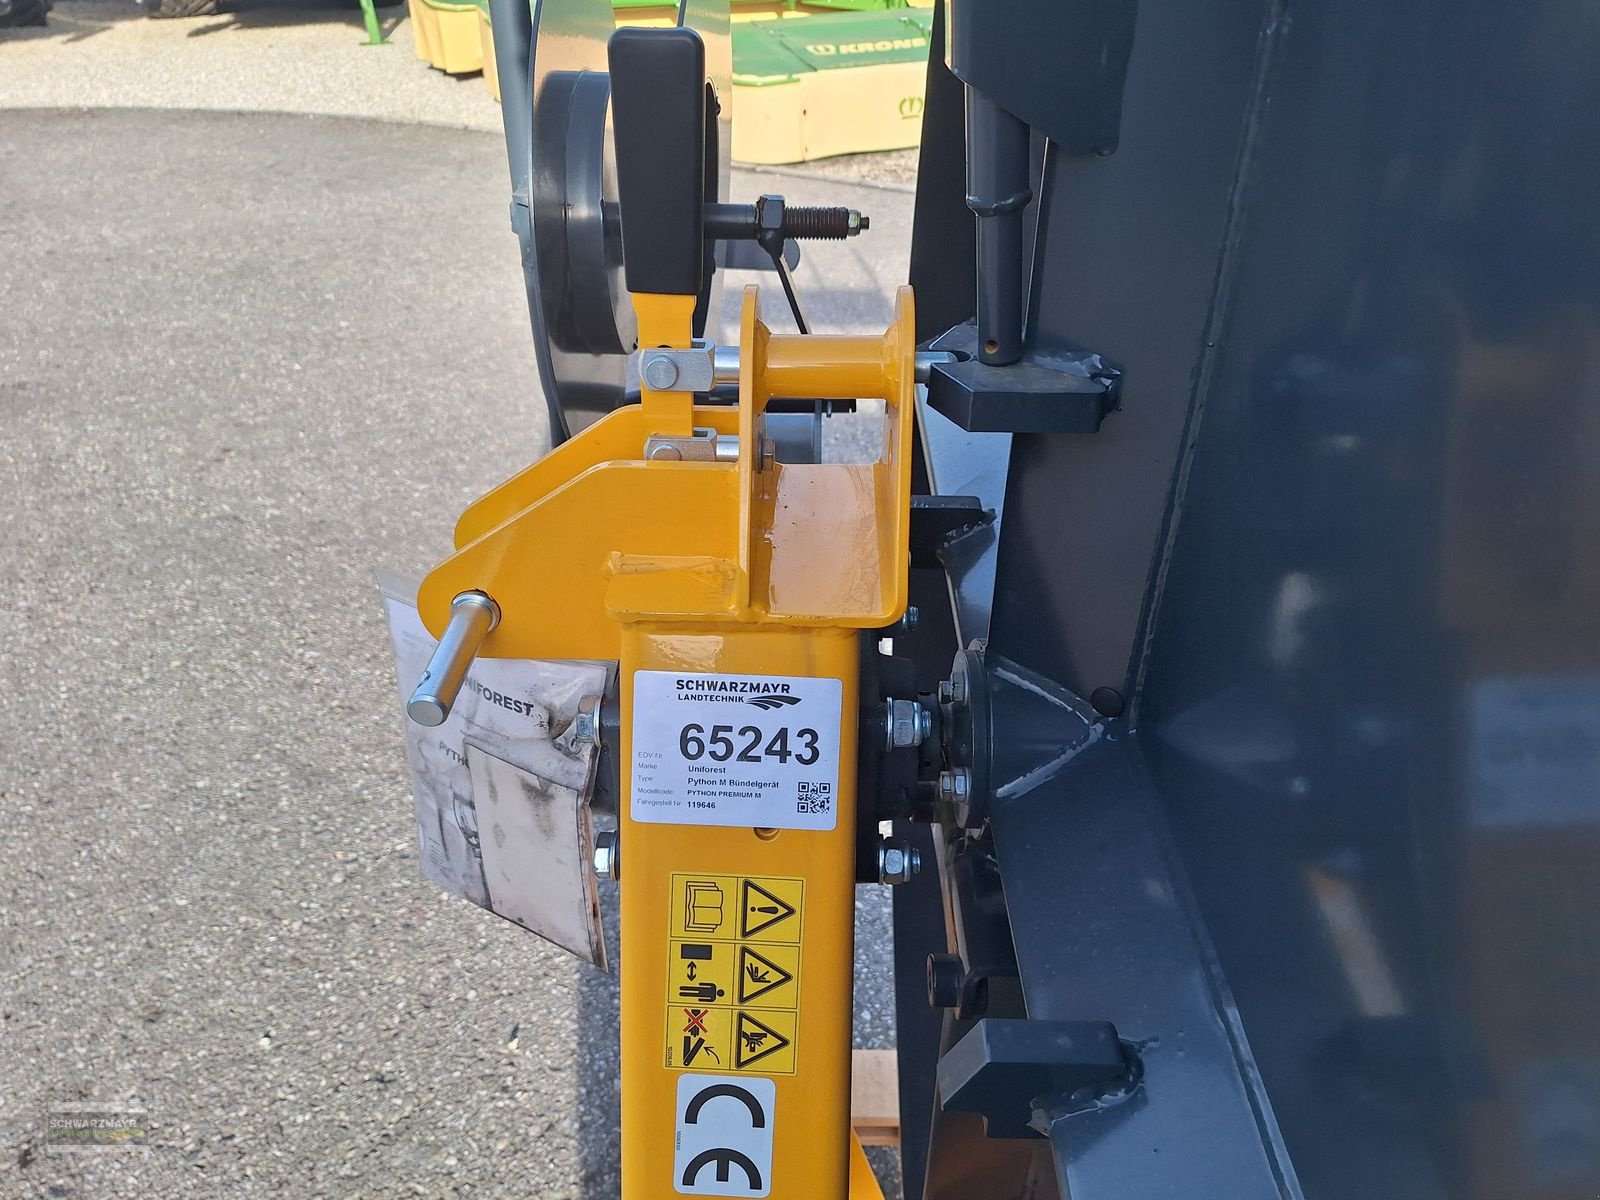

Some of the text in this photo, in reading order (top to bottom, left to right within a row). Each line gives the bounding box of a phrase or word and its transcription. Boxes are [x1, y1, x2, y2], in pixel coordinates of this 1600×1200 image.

[839, 37, 927, 54] KRONE
[676, 679, 791, 694] SCHWARZMAYR
[465, 677, 534, 716] NIFOREST
[677, 693, 745, 703] LANDTECHNIK
[679, 723, 820, 765] 65243
[638, 762, 658, 770] Marke
[688, 765, 726, 774] Uniforest
[638, 775, 653, 783] Type
[687, 777, 717, 788] Python
[729, 778, 780, 789] Bündelgerät
[637, 787, 674, 795] Modellcode
[718, 791, 753, 799] PREMIUM
[637, 799, 672, 807] Fahrgestell
[687, 801, 716, 809] 119646
